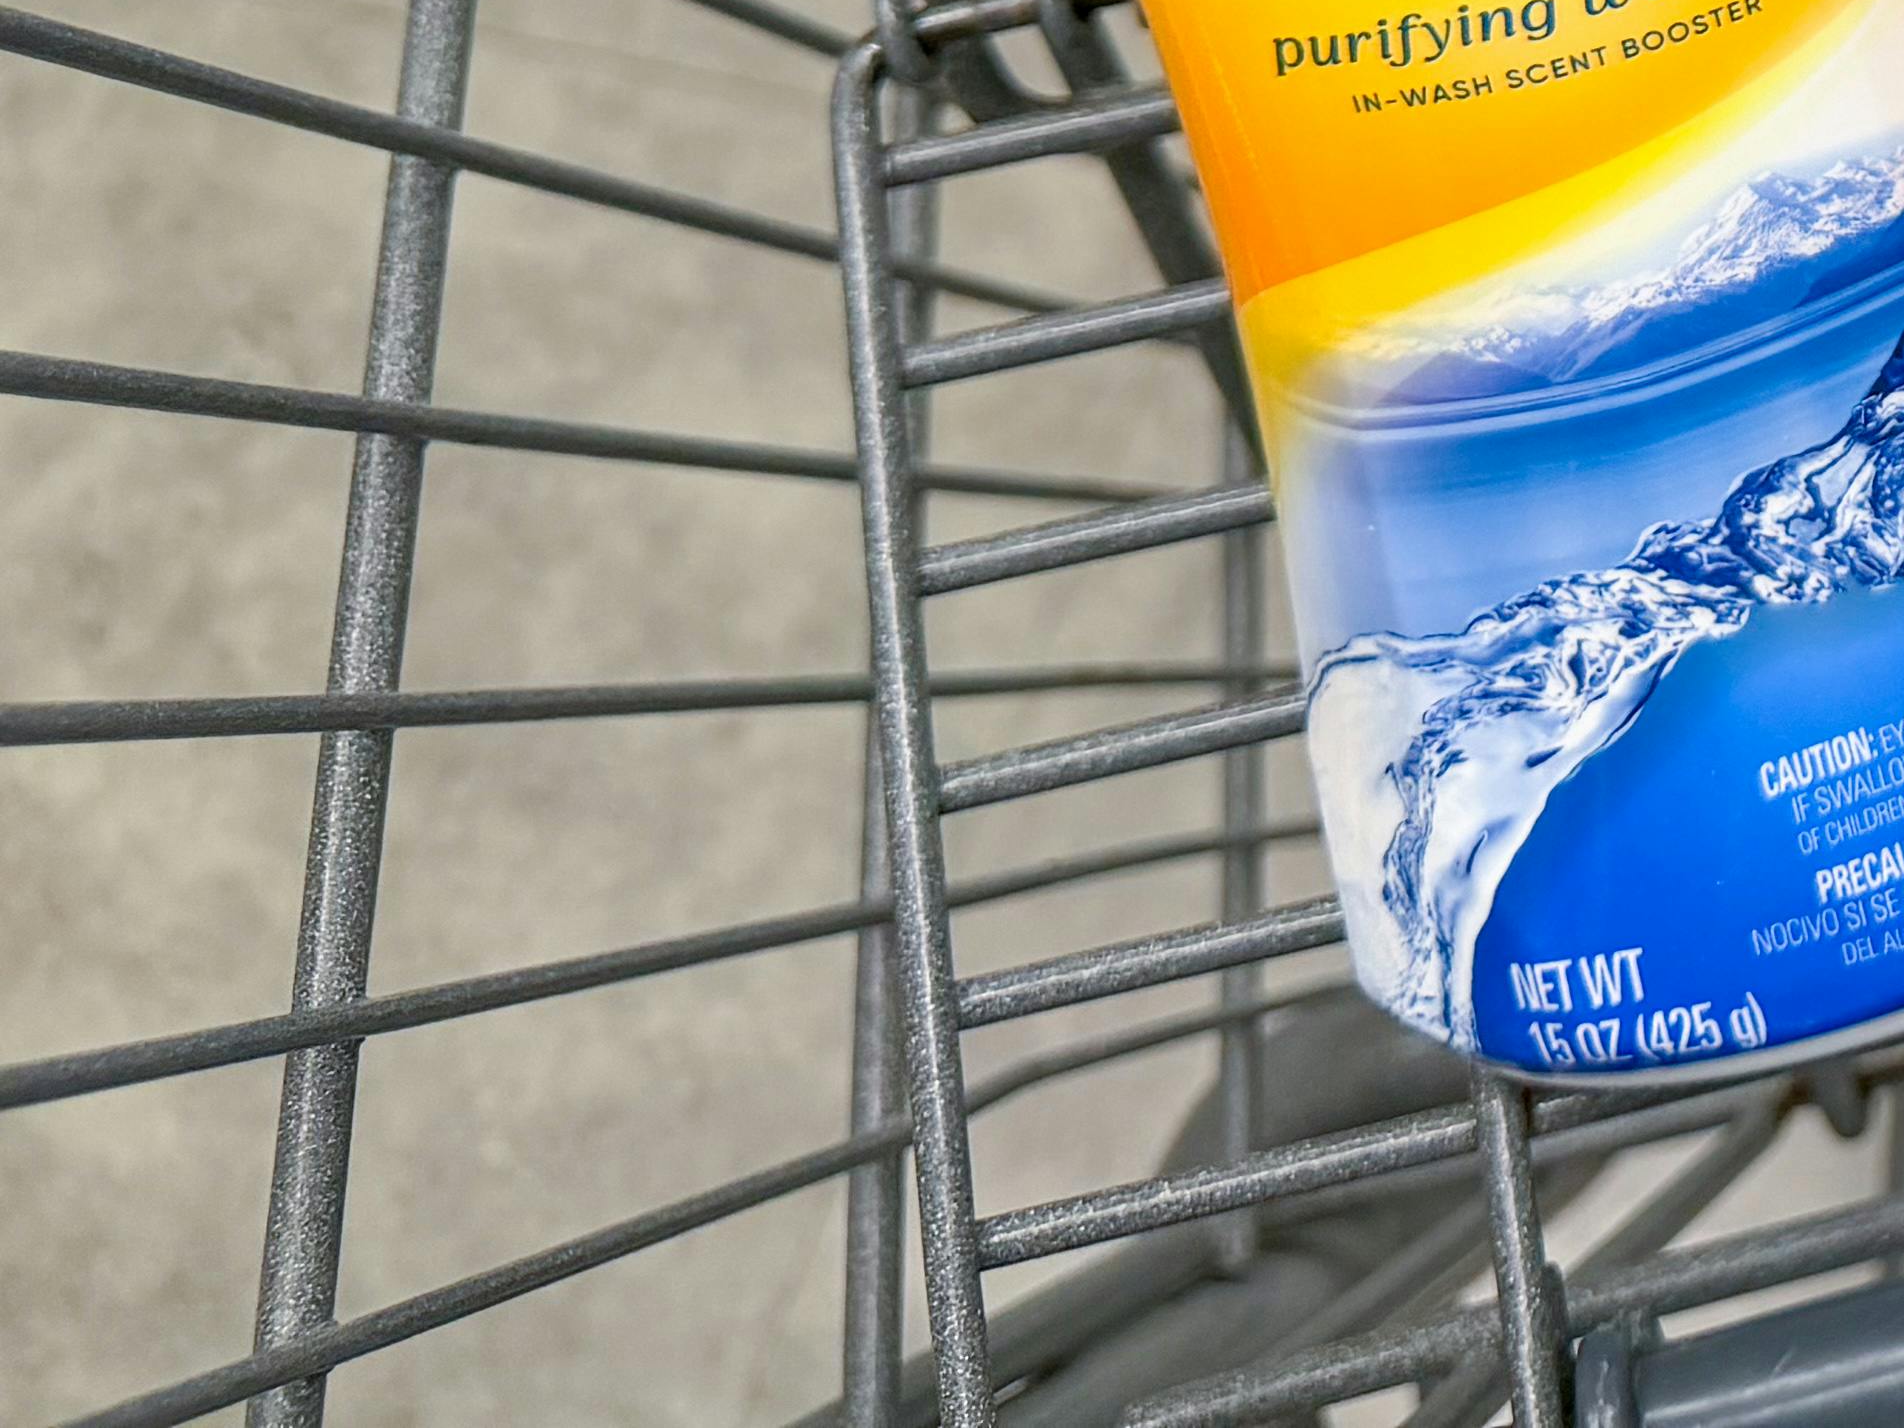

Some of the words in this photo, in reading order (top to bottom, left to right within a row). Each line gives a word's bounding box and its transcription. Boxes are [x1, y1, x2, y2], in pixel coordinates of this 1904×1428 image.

[1352, 72, 1492, 113] IN-WASH
[1506, 45, 1608, 90] SCENT
[1758, 726, 1880, 799] CAUTION:
[1791, 793, 1814, 825] IF
[1798, 830, 1823, 856] OF
[1751, 906, 1840, 956] NOCIVO
[1848, 901, 1867, 927] SI
[1873, 892, 1901, 922] SE
[1841, 938, 1879, 966] DEL
[1509, 958, 1577, 1013] NET
[1580, 947, 1645, 1009] WT
[1527, 1018, 1576, 1066] 15
[1574, 1017, 1635, 1064] OZ
[1634, 1002, 1723, 1062] (425
[1727, 991, 1769, 1047] g)
